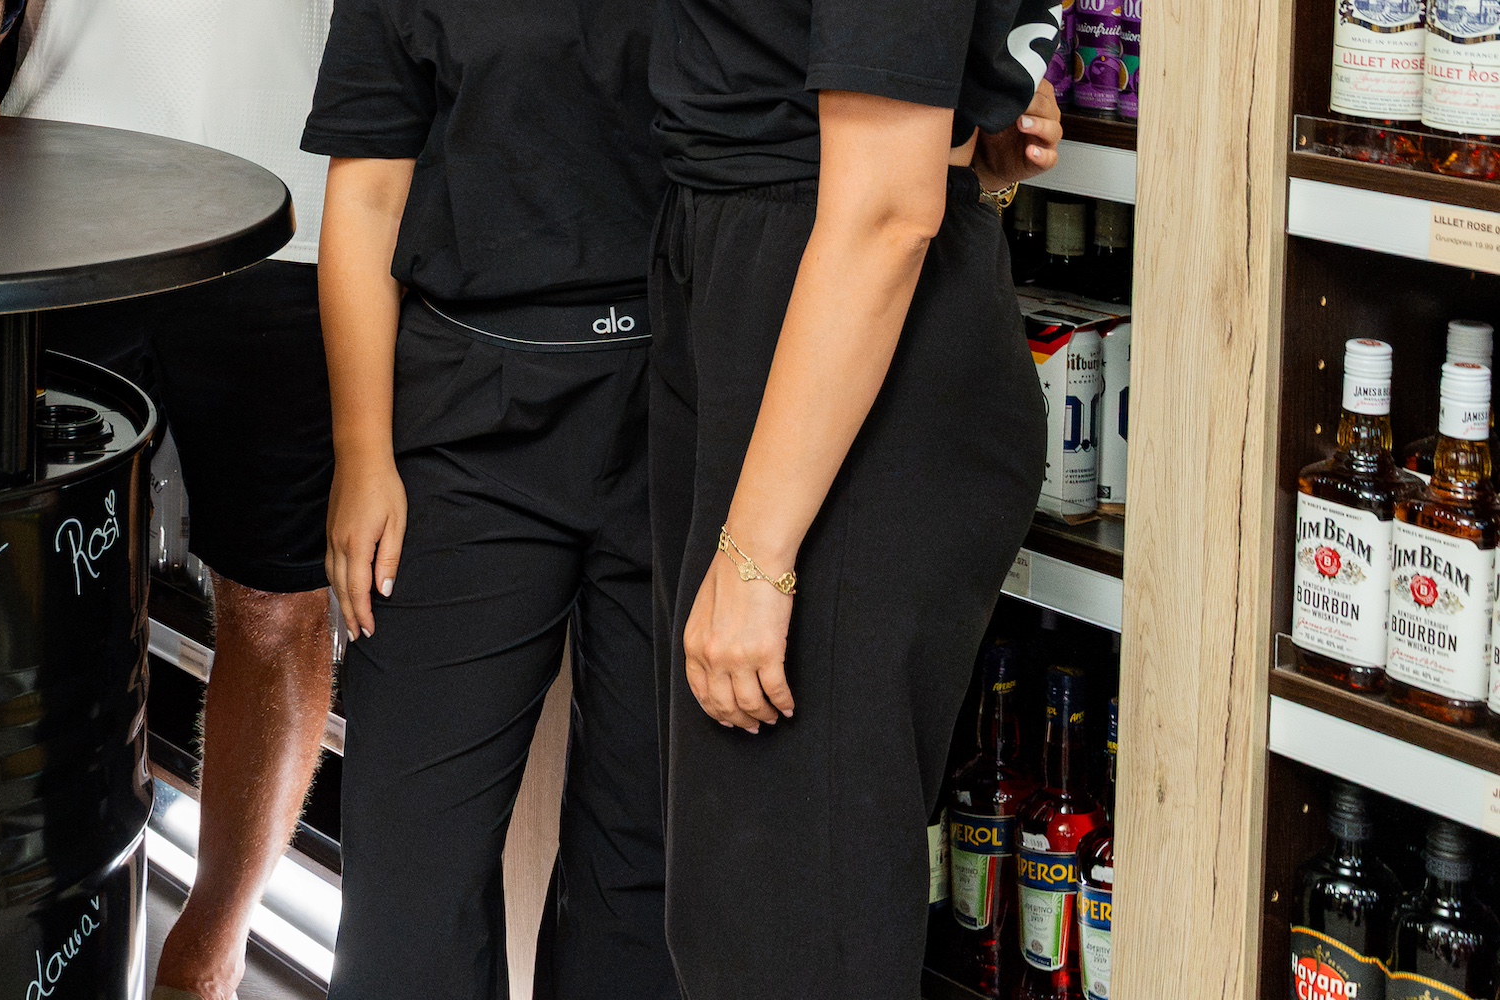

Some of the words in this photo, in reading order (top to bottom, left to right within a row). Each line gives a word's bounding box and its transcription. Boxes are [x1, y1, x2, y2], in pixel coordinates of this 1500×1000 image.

[1343, 52, 1386, 68] LILLET
[1427, 62, 1463, 80] LILLET
[1433, 215, 1465, 228] LILLET
[1467, 220, 1494, 234] ROSE
[592, 306, 635, 334] alo
[1296, 516, 1320, 543] JIM
[1324, 517, 1375, 567] BEAM
[1391, 544, 1416, 571] JIM
[1419, 545, 1472, 596] BEAM
[1297, 585, 1360, 621] BOURBON
[1312, 606, 1340, 625] WHISKEY
[1391, 614, 1458, 652] BOURBON
[1407, 636, 1436, 655] WHISKEY
[1291, 952, 1358, 997] Havana
